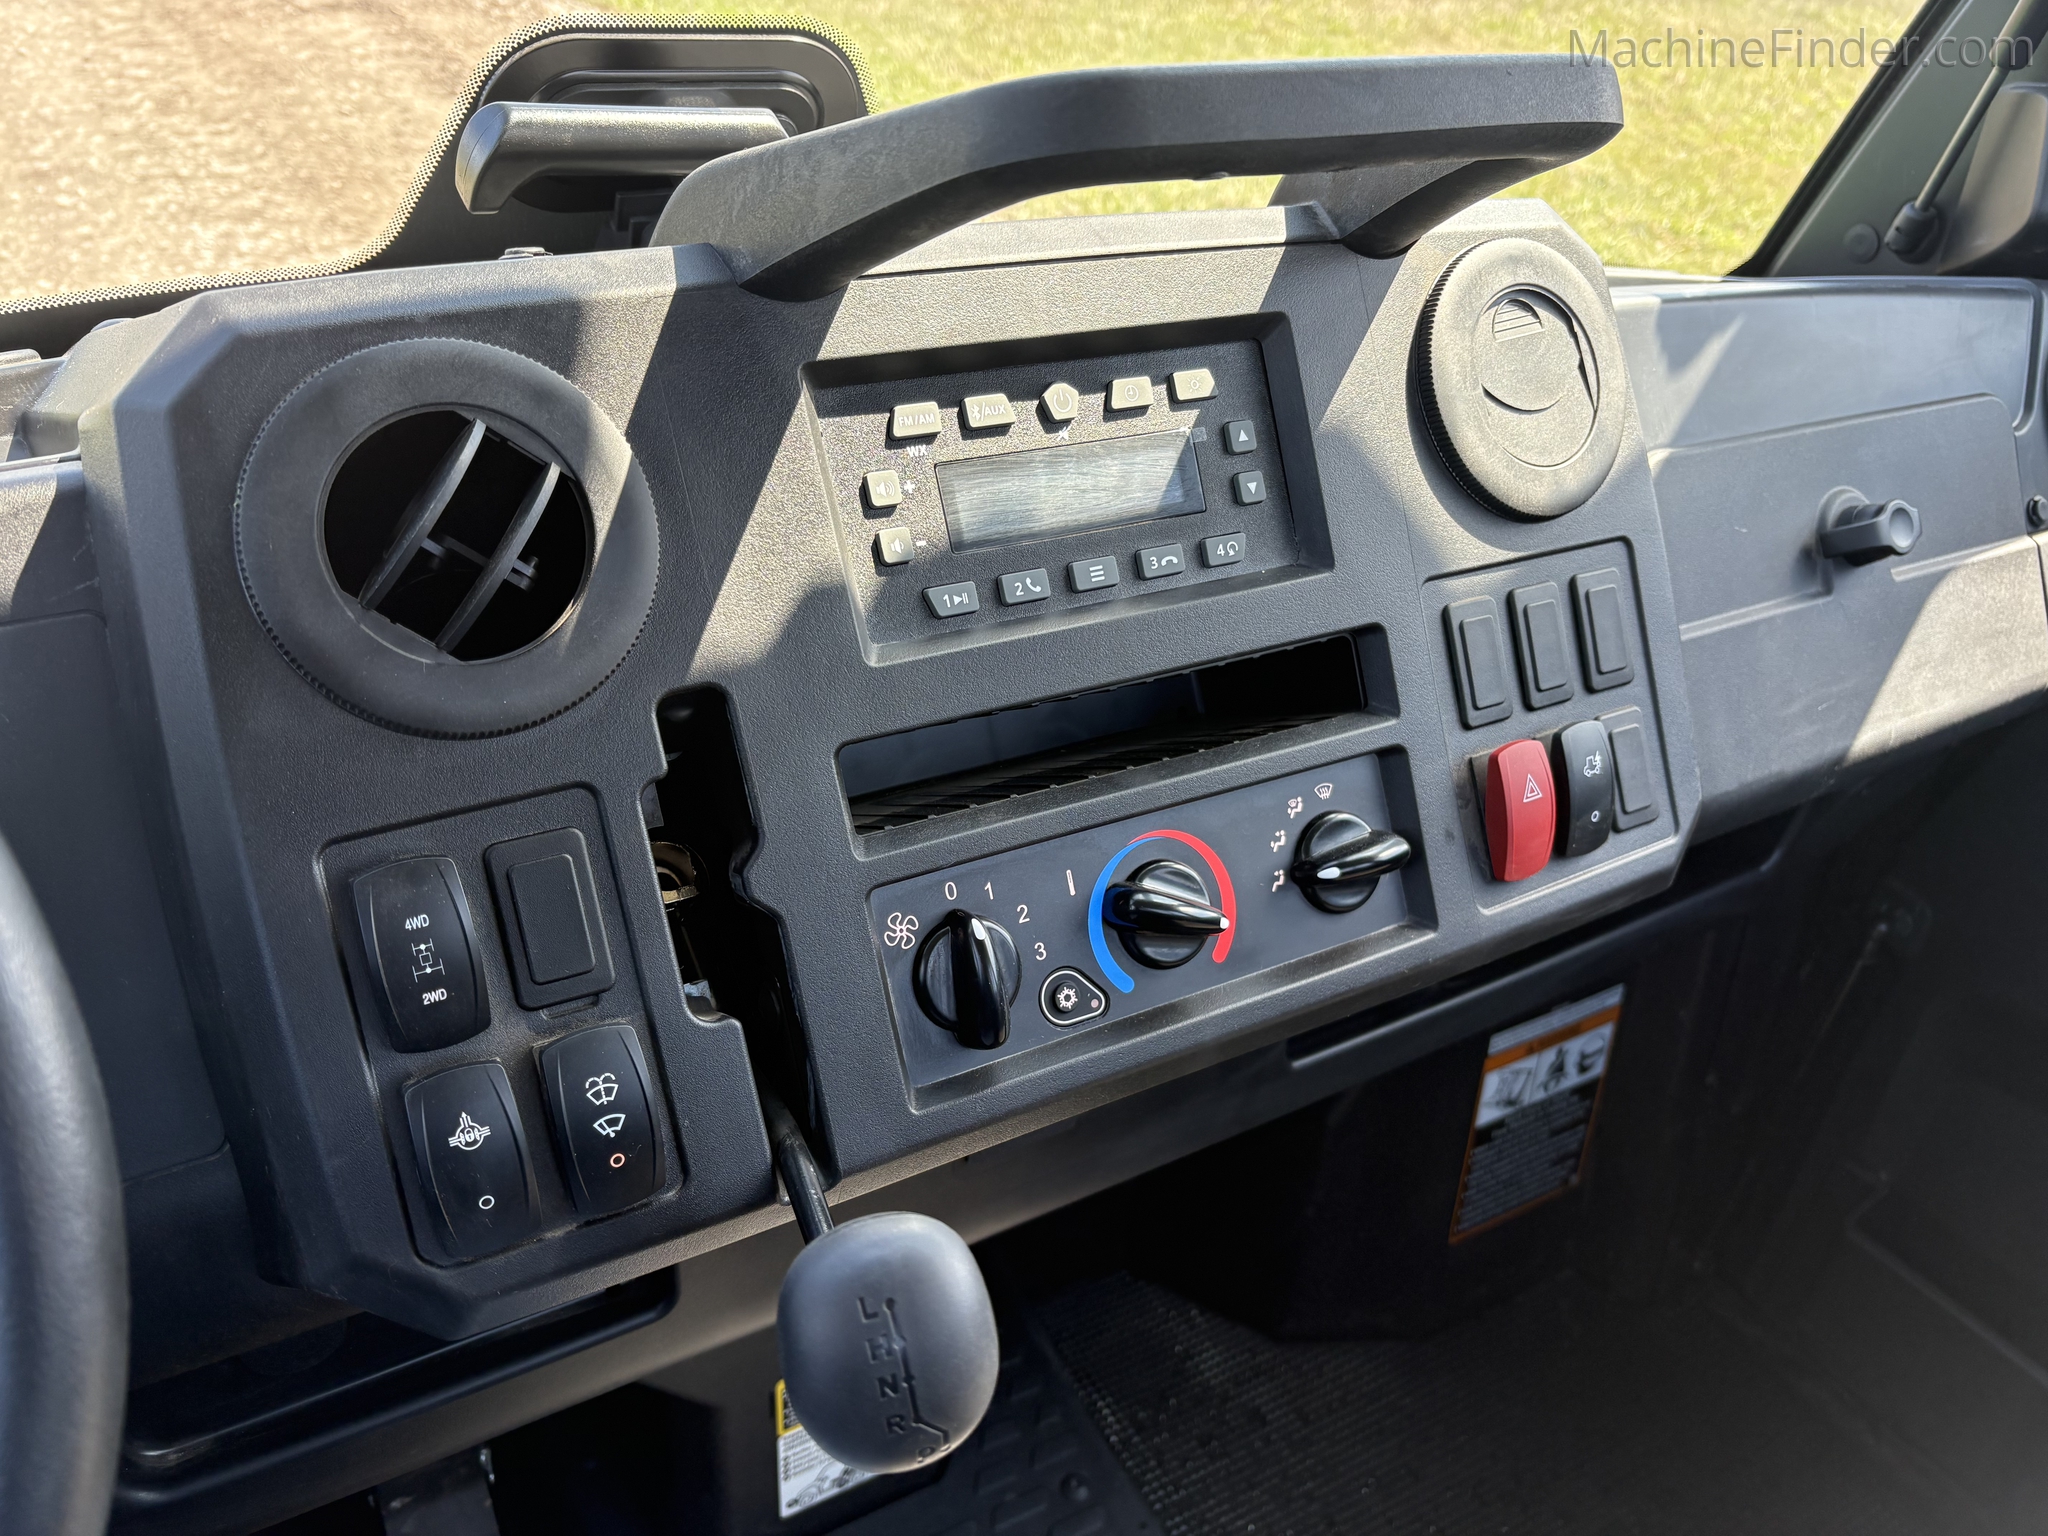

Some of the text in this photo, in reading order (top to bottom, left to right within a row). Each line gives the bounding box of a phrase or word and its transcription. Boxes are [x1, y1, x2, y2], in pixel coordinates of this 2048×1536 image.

[898, 412, 935, 427] FM/AM
[906, 445, 928, 457] WX
[1216, 543, 1225, 557] 4
[1150, 556, 1159, 570] 3
[1014, 582, 1024, 597] 2
[943, 593, 951, 608] 1
[984, 881, 993, 900] 1
[1016, 904, 1030, 923] 2
[405, 914, 429, 931] 4WD
[1034, 942, 1048, 961] 3
[422, 988, 447, 1005] 2WD
[858, 1296, 879, 1323] L
[866, 1334, 893, 1364] H
[877, 1373, 899, 1399] N
[885, 1413, 906, 1434] R
